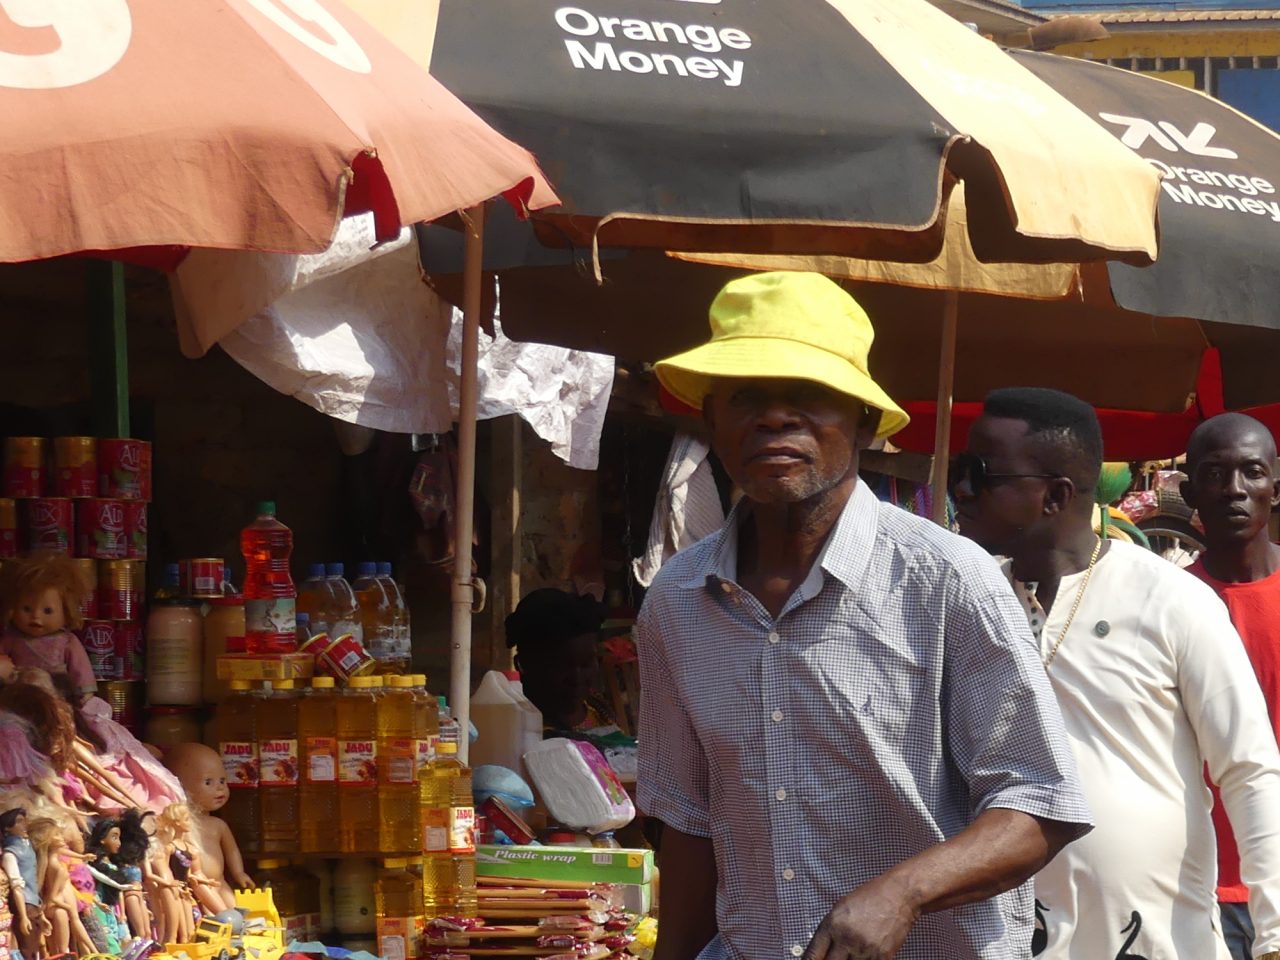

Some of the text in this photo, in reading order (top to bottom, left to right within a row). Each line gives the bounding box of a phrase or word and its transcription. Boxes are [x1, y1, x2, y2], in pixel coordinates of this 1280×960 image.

[554, 6, 752, 53] Orange
[564, 39, 744, 87] Money
[456, 809, 473, 820] JADU
[494, 850, 577, 863] Plastic wrap
